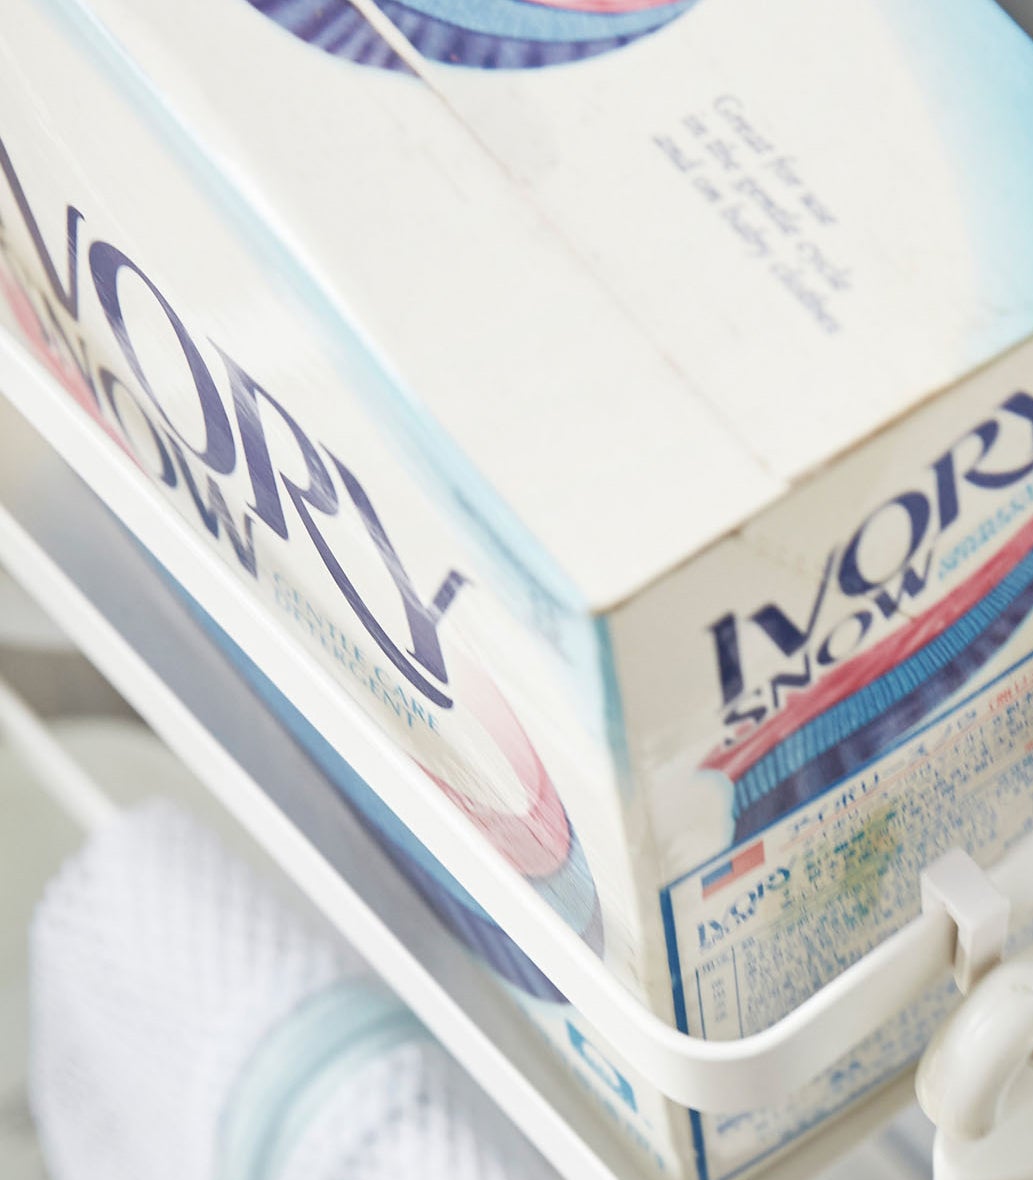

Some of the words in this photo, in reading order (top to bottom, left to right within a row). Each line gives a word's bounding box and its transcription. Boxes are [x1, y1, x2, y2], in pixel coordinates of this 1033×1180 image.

[0, 136, 473, 708] VORY
[373, 665, 442, 738] CARE
[722, 548, 935, 748] SNOW
